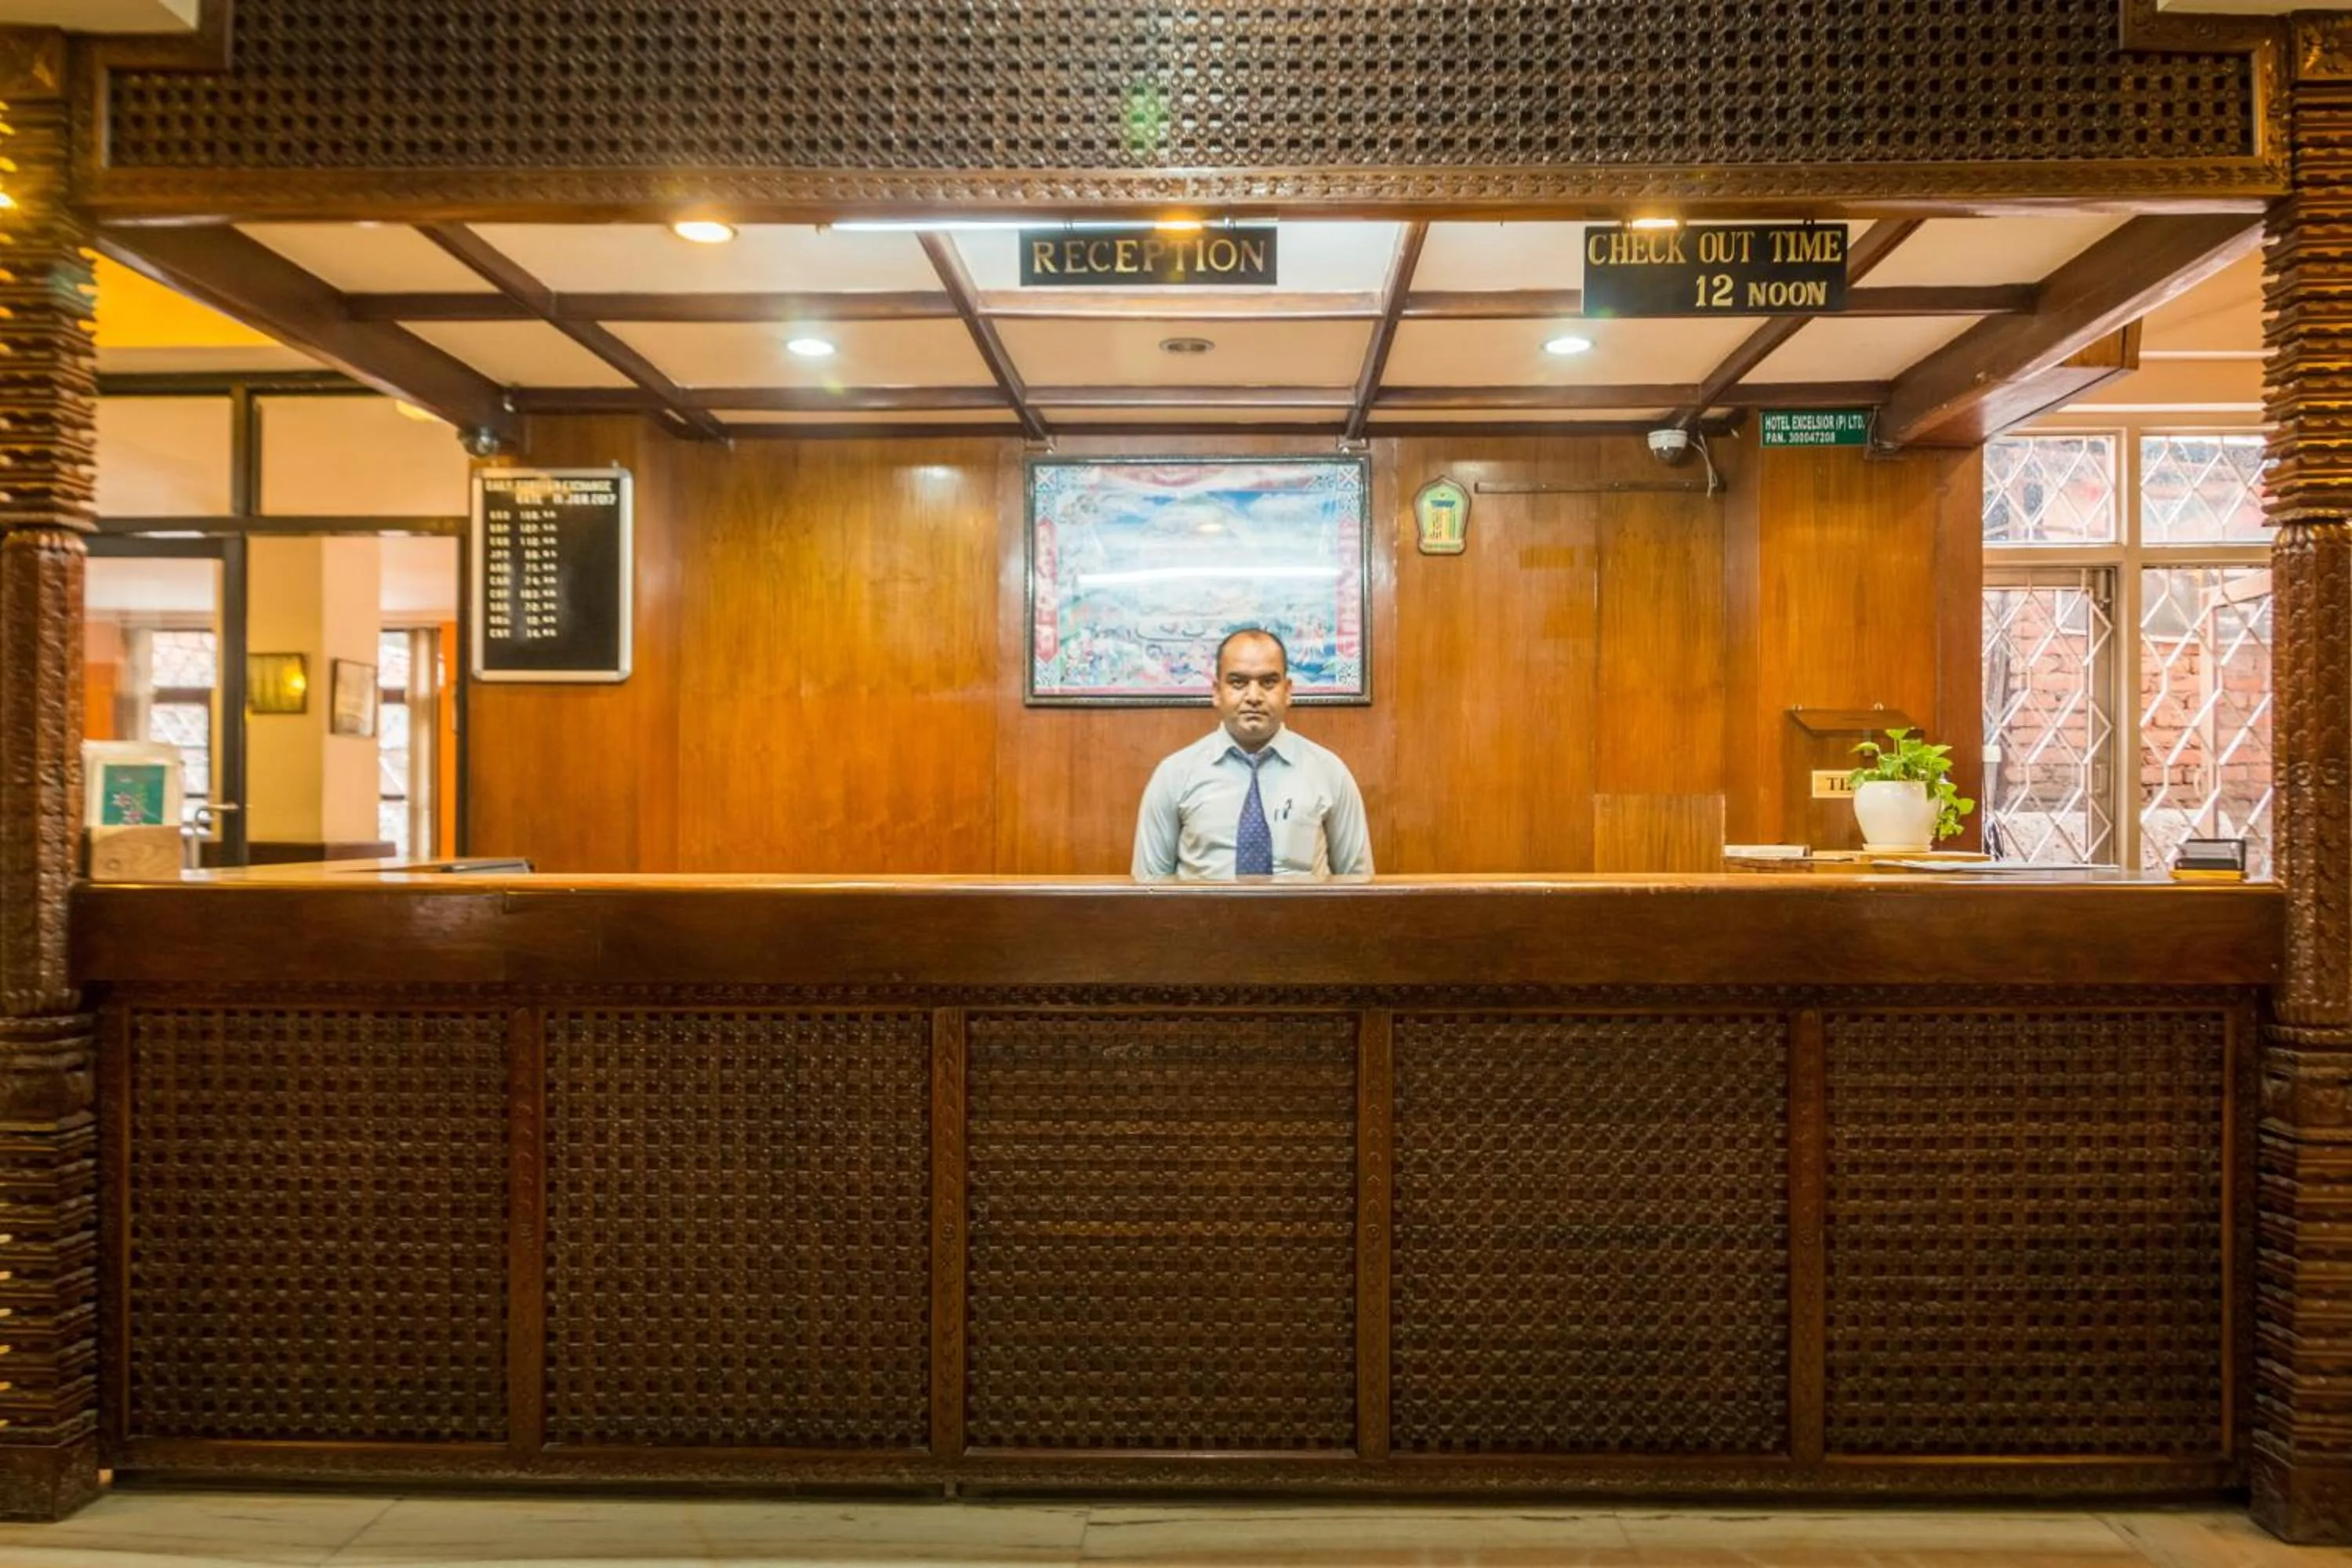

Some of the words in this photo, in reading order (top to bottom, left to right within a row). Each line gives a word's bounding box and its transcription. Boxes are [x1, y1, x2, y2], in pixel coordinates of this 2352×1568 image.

[1032, 239, 1265, 274] RECEPTION
[1588, 232, 1687, 265] CHECK
[1700, 231, 1755, 263] OUT
[1769, 231, 1842, 263] TIME
[1695, 274, 1733, 307] 12
[1748, 281, 1828, 307] NOON
[1765, 415, 1791, 430] HOTEL
[1792, 414, 1835, 430] EXCELSIOR
